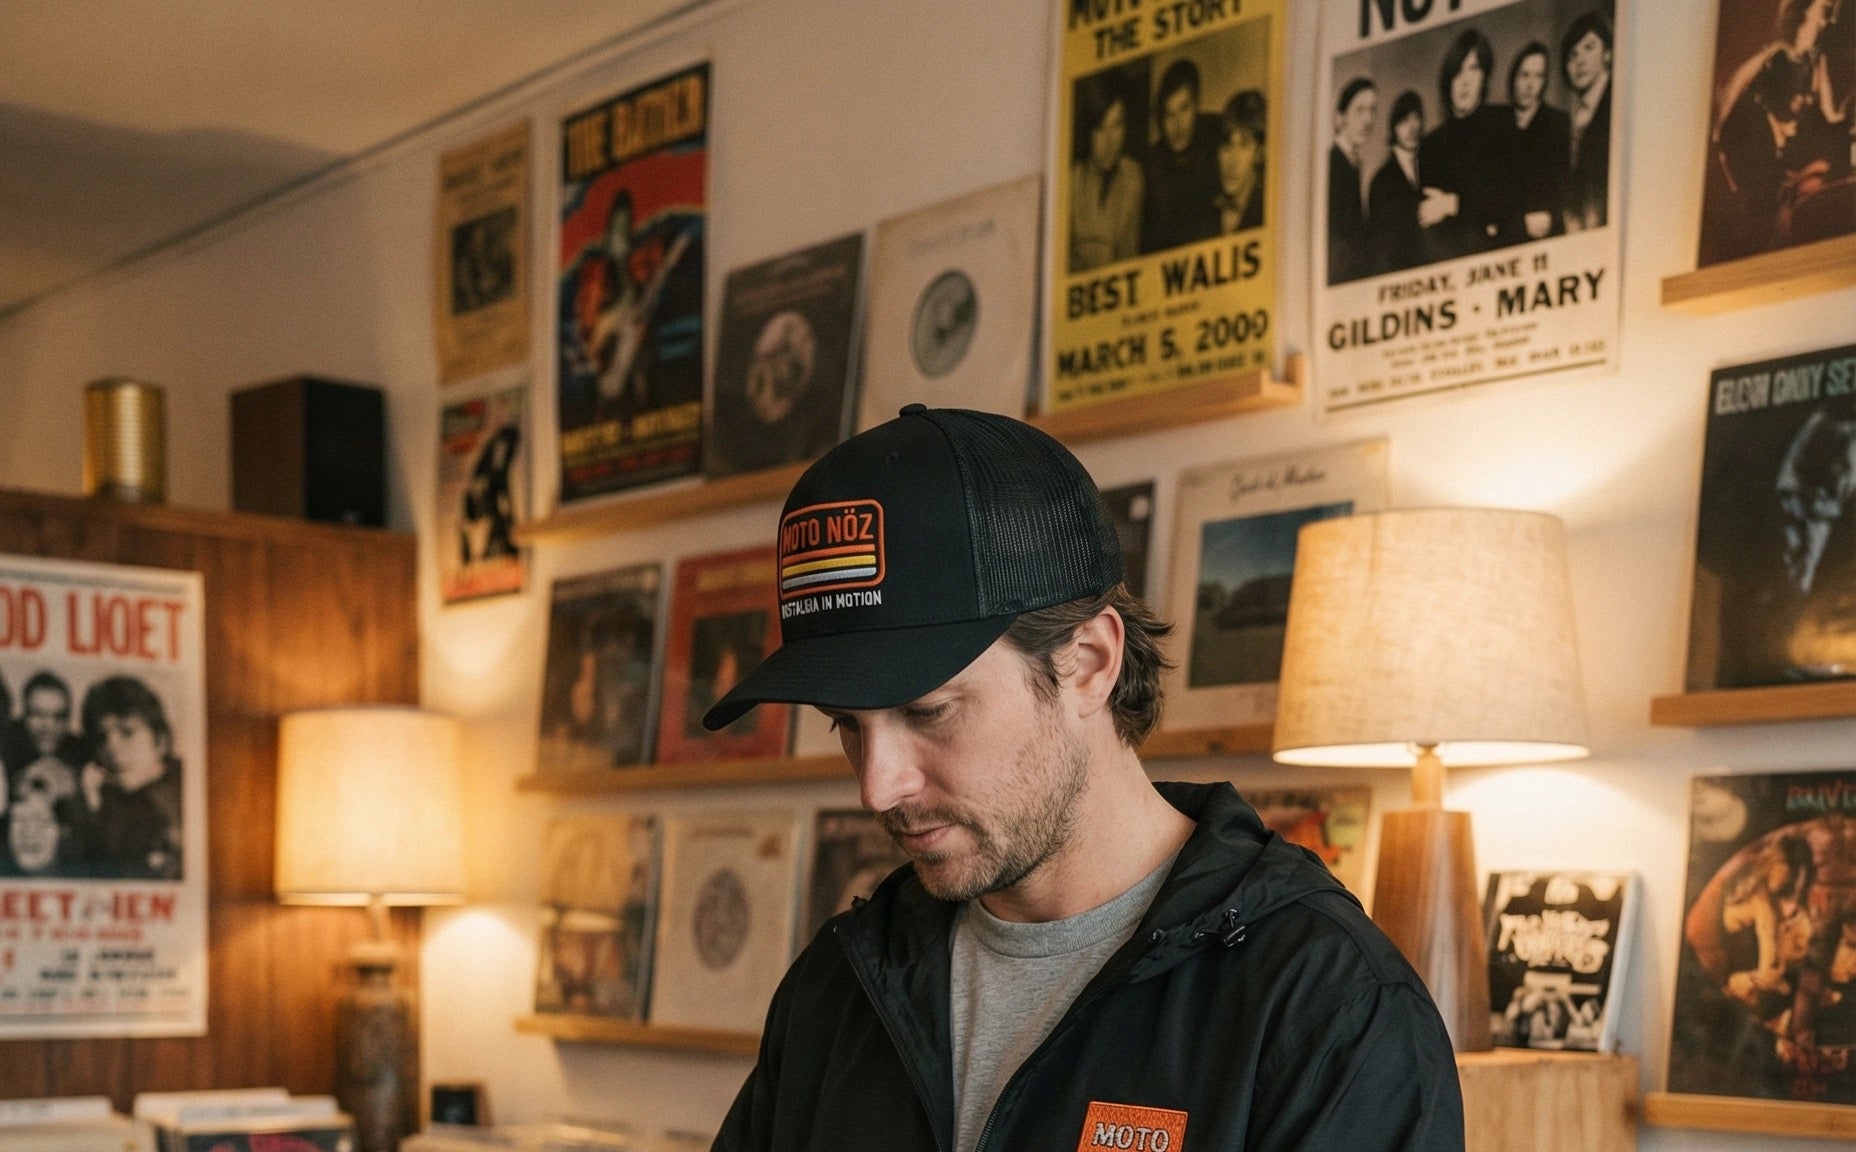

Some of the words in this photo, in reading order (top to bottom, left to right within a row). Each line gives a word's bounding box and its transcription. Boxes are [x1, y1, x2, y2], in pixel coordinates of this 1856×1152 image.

[1095, 16, 1142, 60] THE
[1067, 270, 1142, 319] BEST
[1161, 241, 1261, 297] WALIS
[1328, 300, 1457, 351] GILDINS
[1497, 269, 1606, 318] MARY
[1058, 334, 1148, 378] MARCH
[1196, 309, 1269, 352] 2000
[783, 518, 819, 552] MOTO
[827, 507, 874, 543] NÖZ
[822, 595, 833, 611] IN
[836, 590, 882, 608] MOTION
